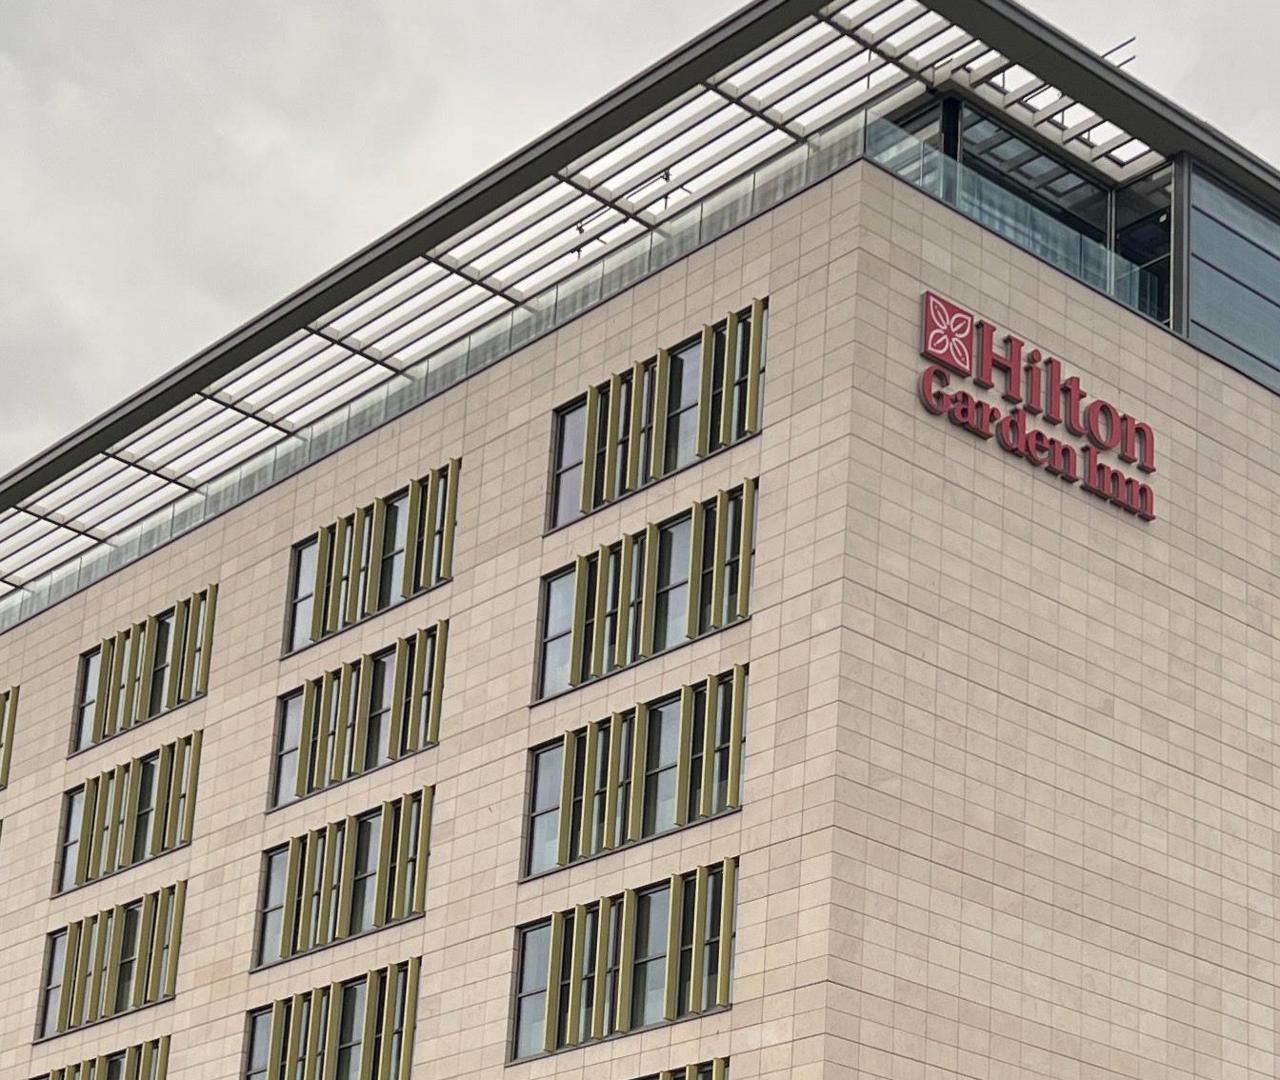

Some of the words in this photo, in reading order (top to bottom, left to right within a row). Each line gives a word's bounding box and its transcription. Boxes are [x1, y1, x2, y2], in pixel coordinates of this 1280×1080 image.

[918, 364, 1078, 484] Garden
[1080, 443, 1156, 522] Inn
[973, 319, 1156, 473] Hilton
